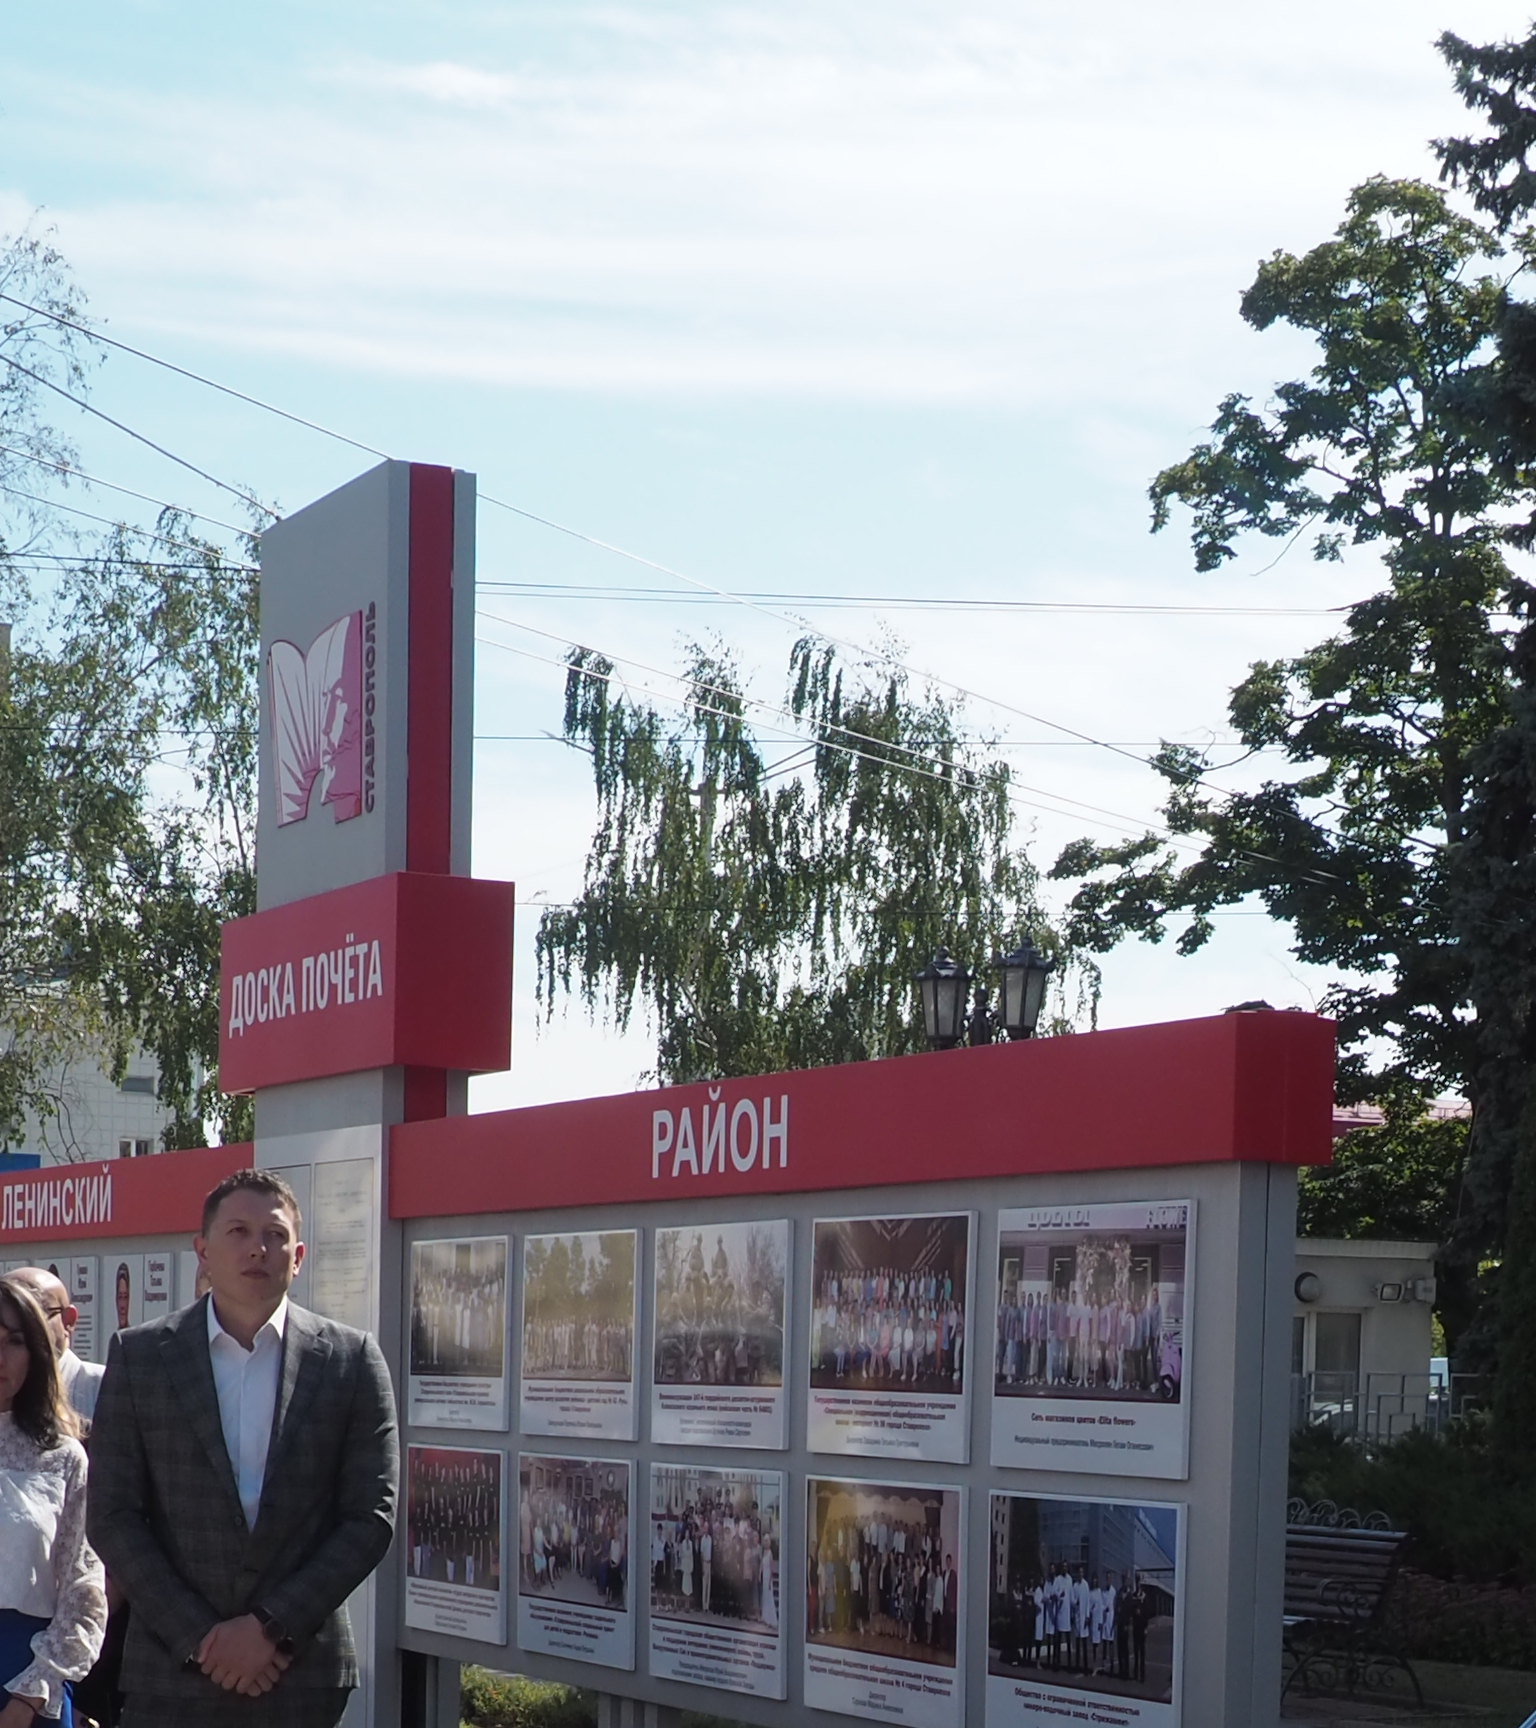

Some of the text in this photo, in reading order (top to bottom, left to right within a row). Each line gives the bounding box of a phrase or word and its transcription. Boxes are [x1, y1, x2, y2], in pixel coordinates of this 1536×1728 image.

[365, 601, 376, 814] СТАВРОПОЛЬ
[229, 932, 383, 1039] ДОСКА ПОЧЁТА
[652, 1085, 789, 1179] РАЙОН
[1, 1163, 112, 1230] ЛЕНИНСКИЙ
